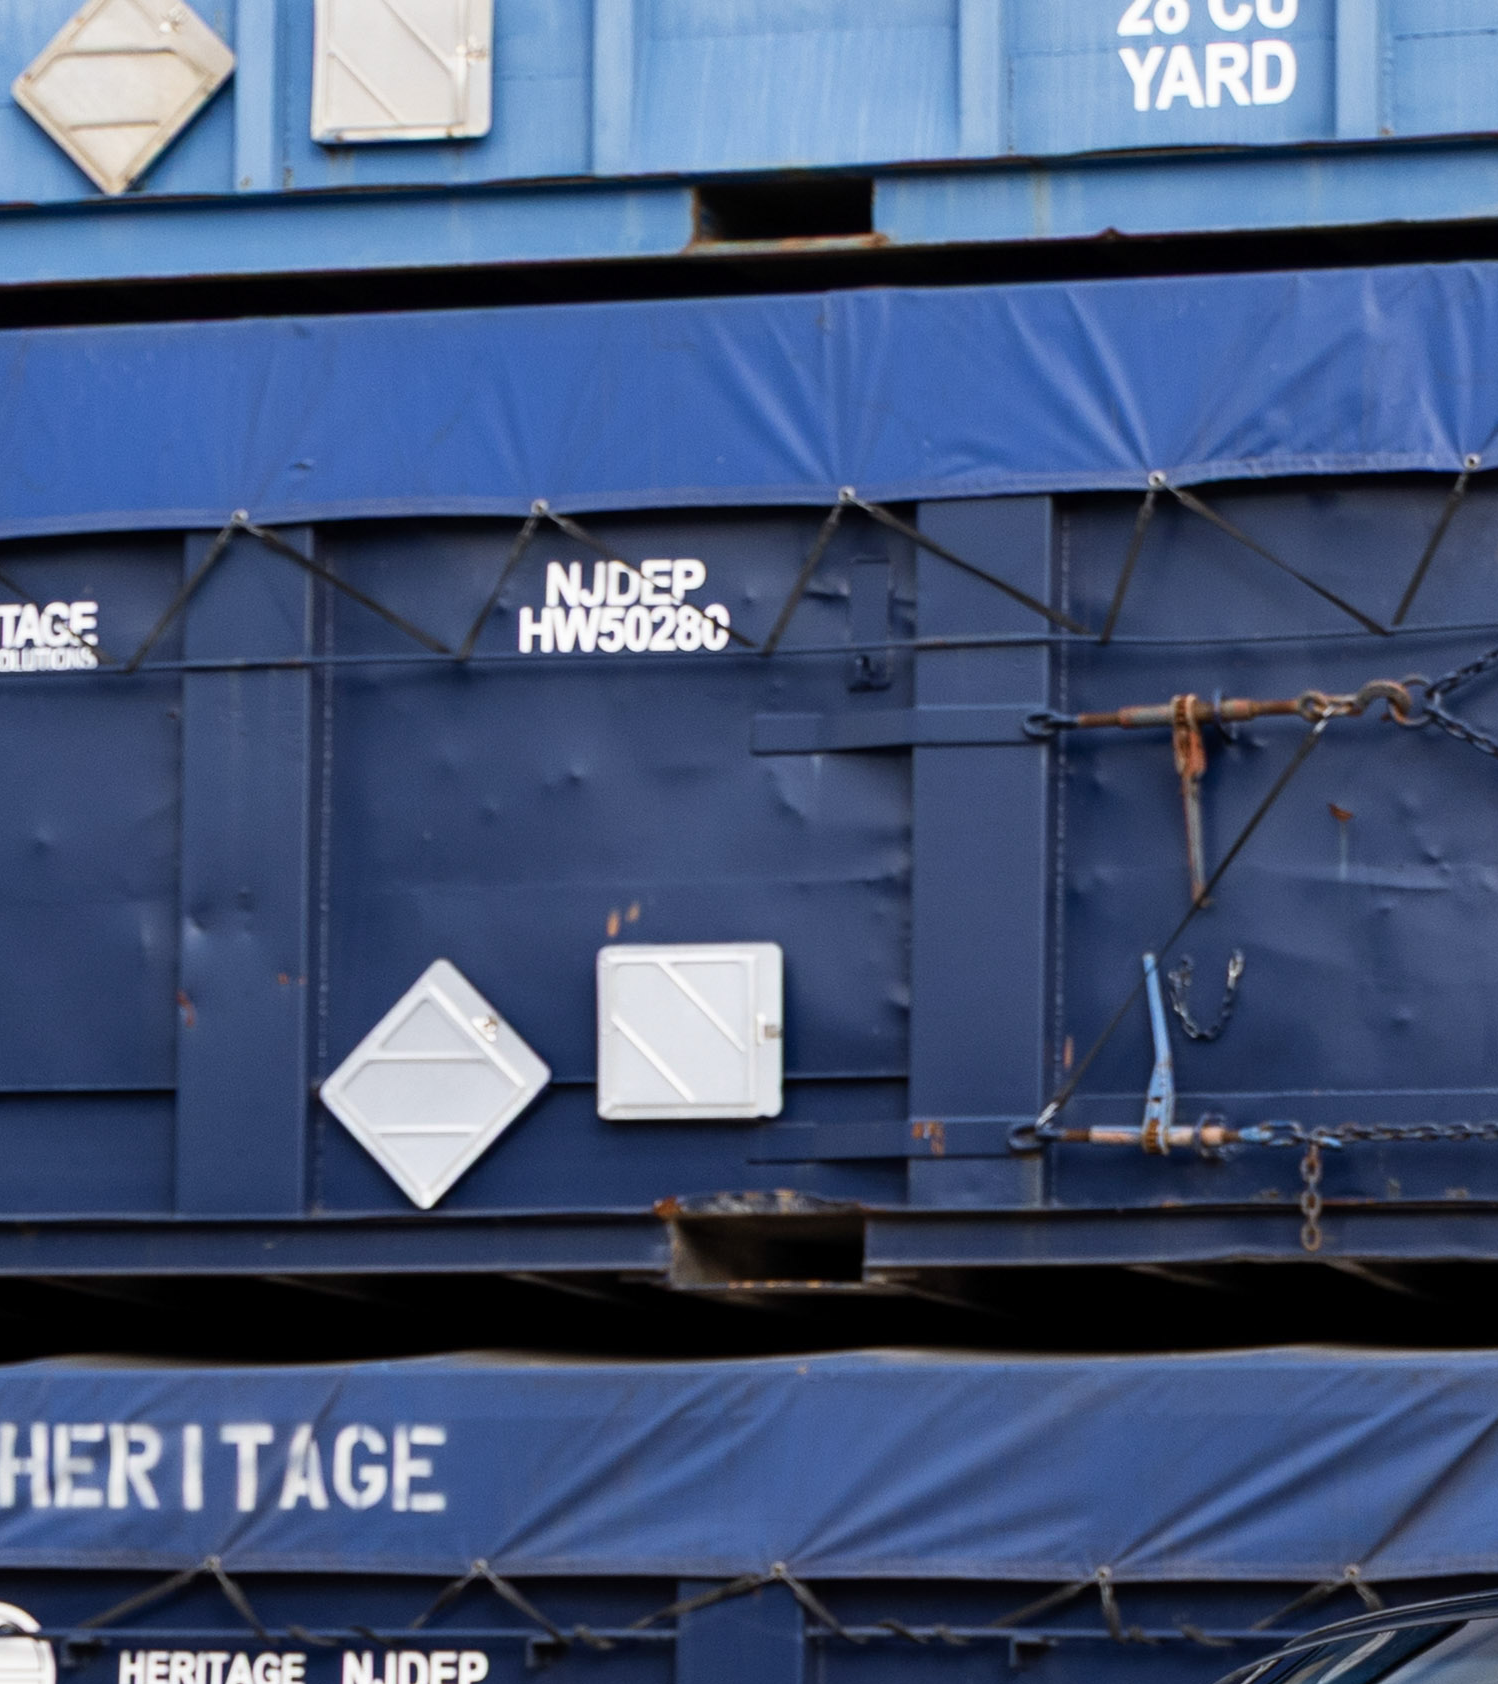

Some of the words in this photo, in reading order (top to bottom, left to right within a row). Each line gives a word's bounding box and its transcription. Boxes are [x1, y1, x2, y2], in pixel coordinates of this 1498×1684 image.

[1118, 39, 1297, 111] YARD
[546, 558, 707, 607] NJDEP
[518, 603, 731, 654] HW50280
